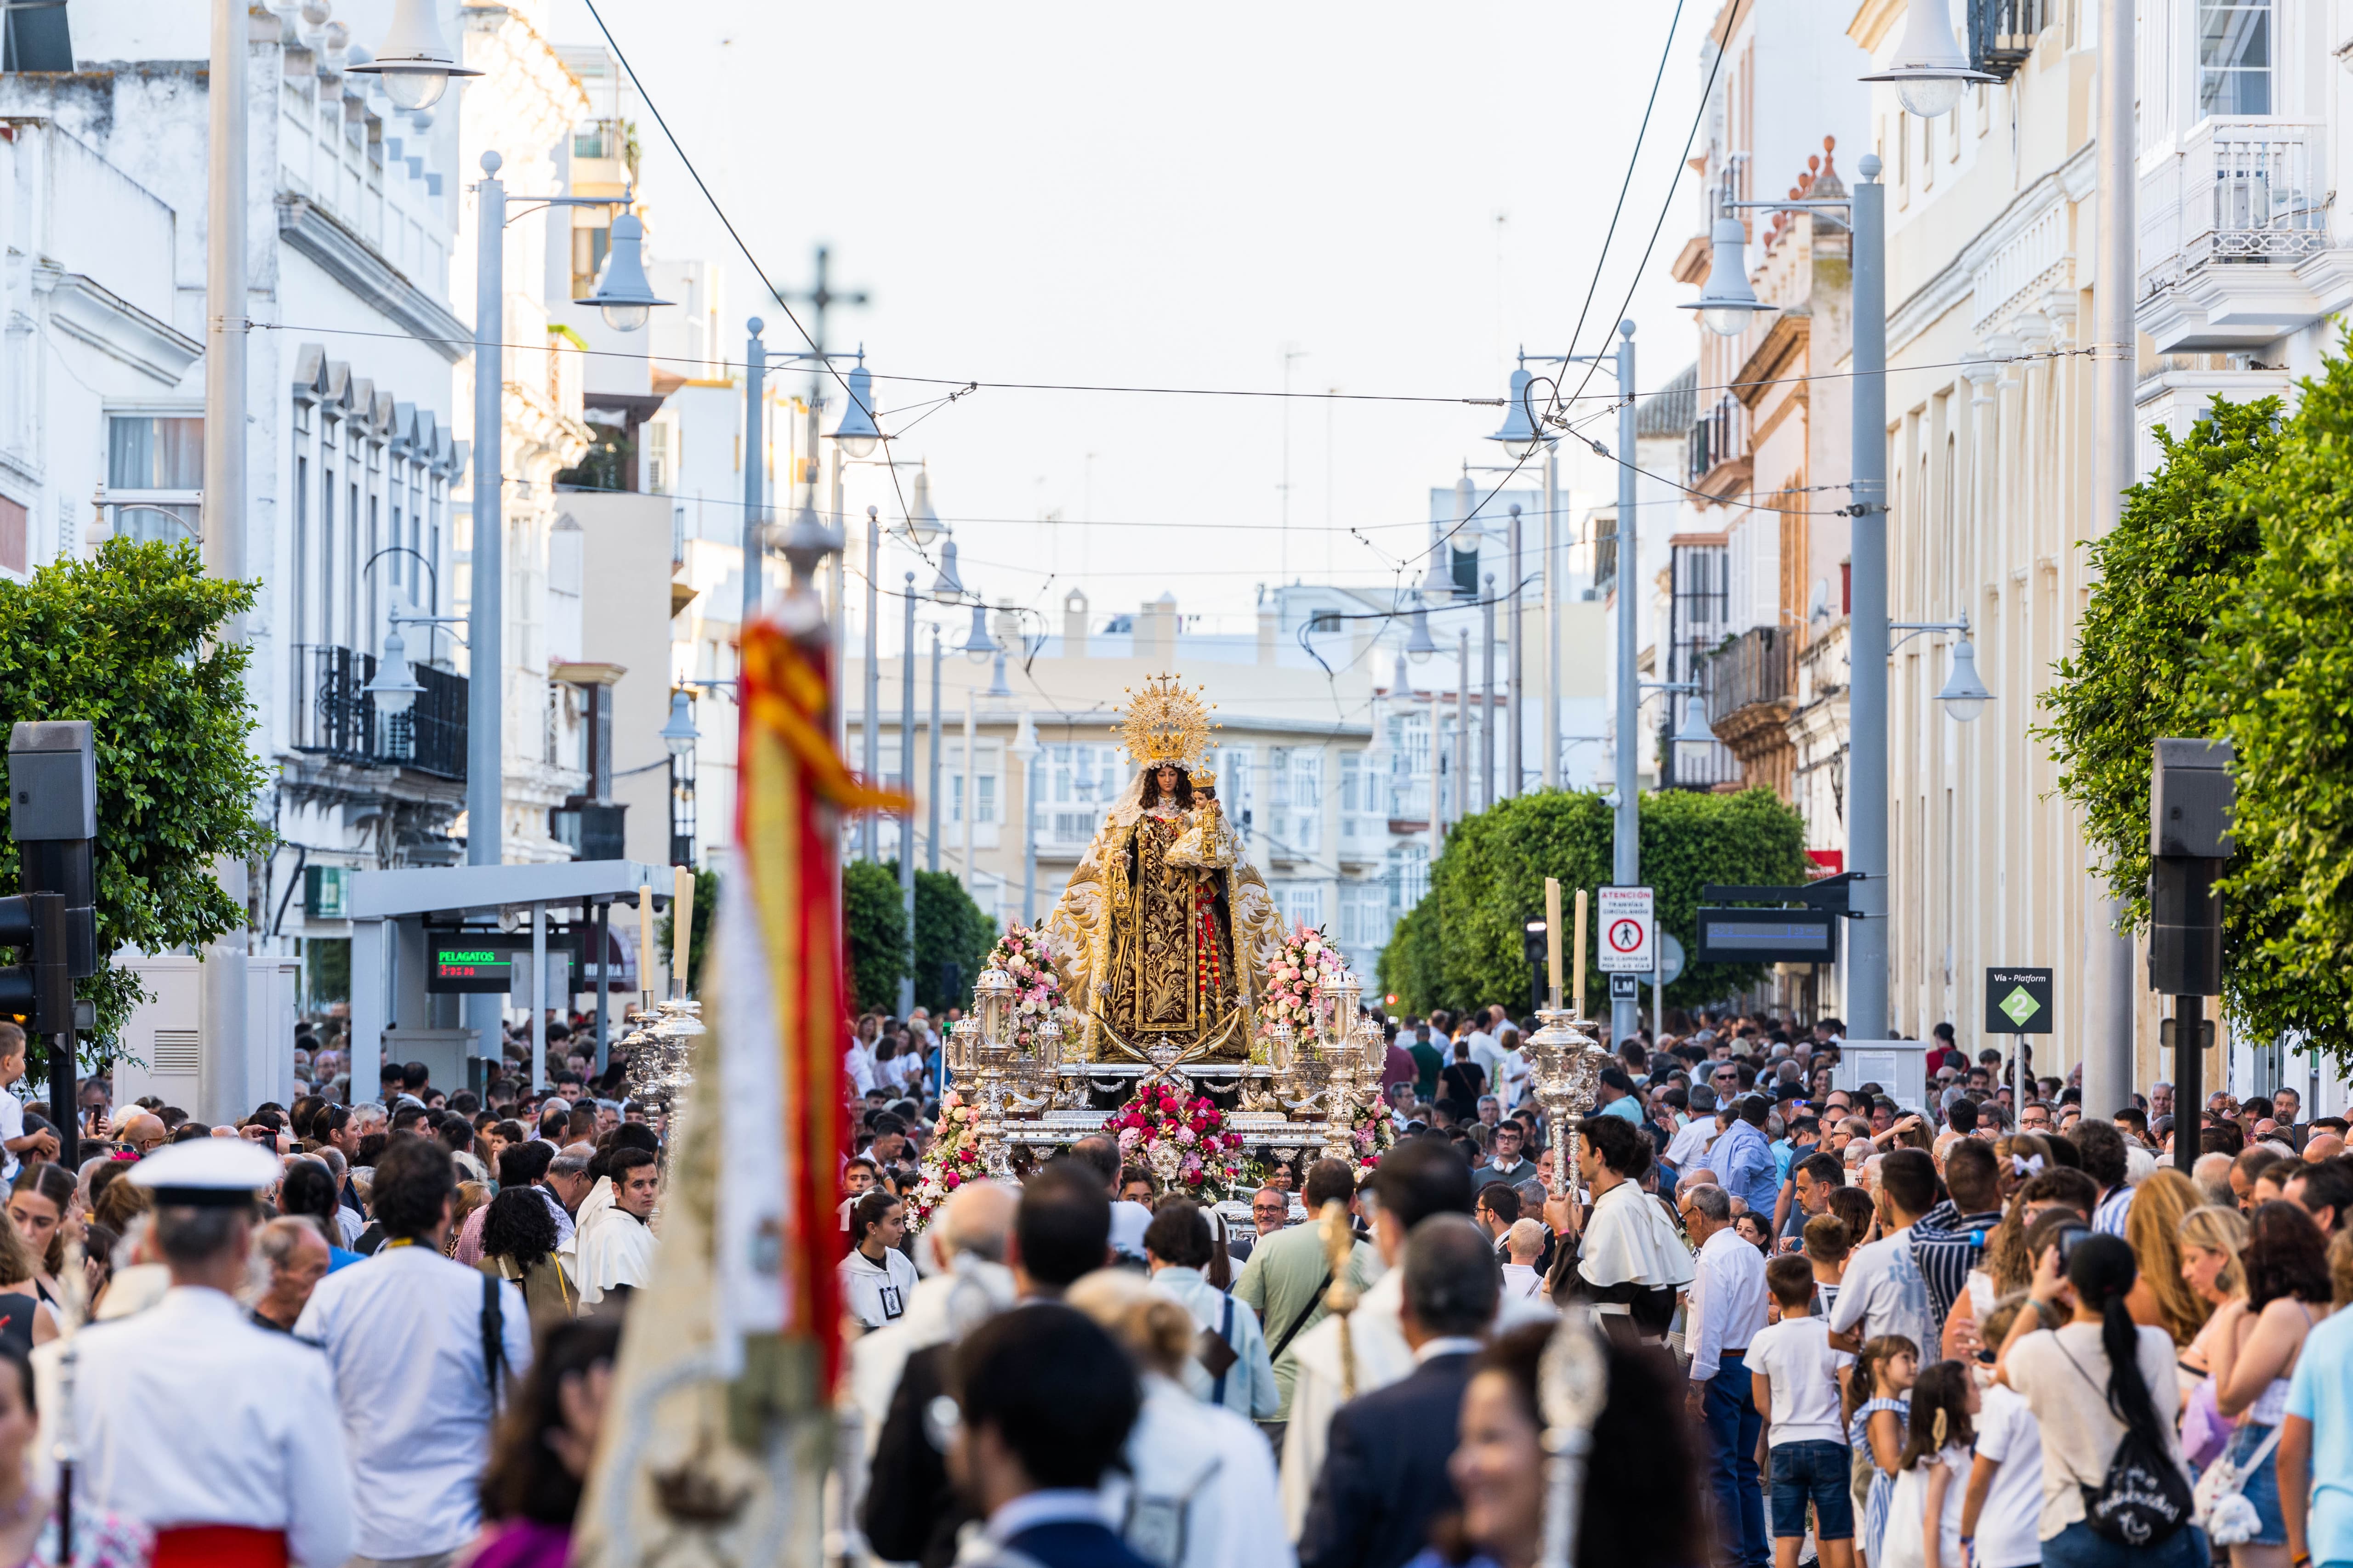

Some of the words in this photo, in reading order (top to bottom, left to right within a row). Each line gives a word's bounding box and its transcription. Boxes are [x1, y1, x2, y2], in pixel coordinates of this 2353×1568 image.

[1602, 890, 1651, 898] ATENCIÓN
[439, 951, 495, 961] PELAGATOS
[2013, 974, 2046, 983] Platform
[1614, 980, 1634, 993] LM
[2012, 994, 2028, 1017] 2
